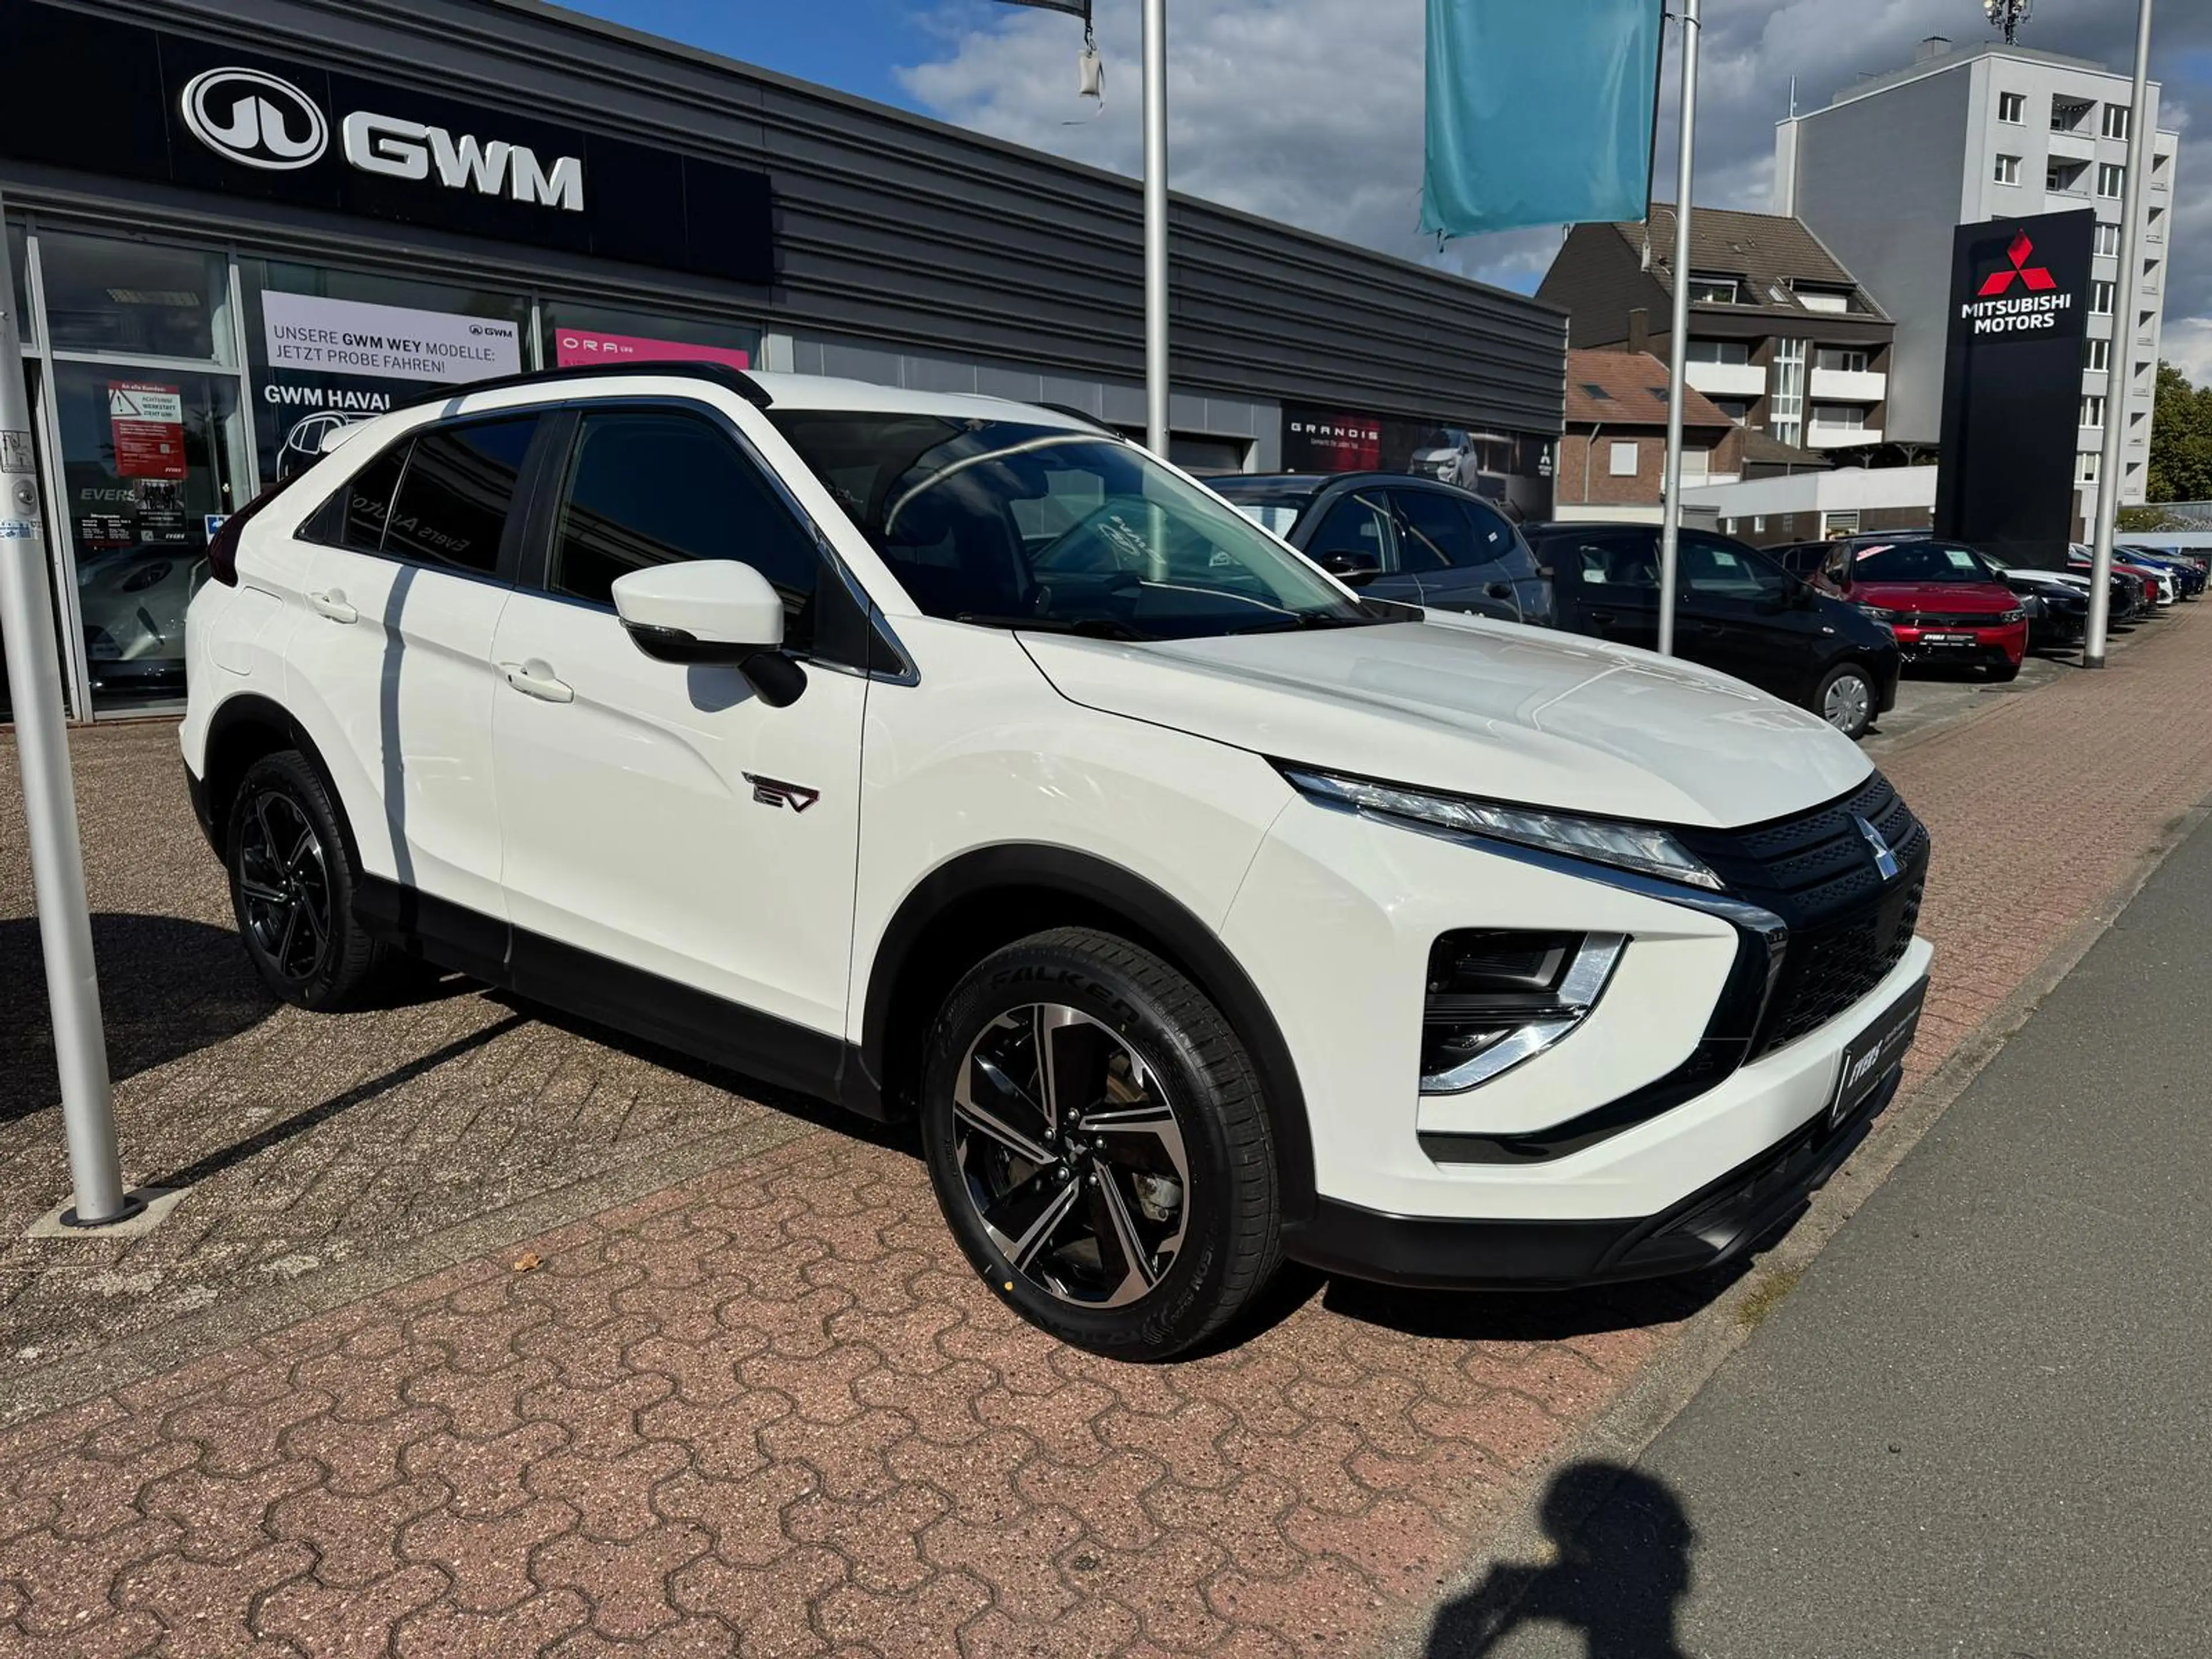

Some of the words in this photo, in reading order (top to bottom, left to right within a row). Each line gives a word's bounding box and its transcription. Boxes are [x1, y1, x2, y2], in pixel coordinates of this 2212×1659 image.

[342, 111, 584, 211] GWM
[1961, 294, 2071, 319] MITSUBISHI
[484, 328, 513, 338] GWM
[1974, 313, 2055, 334] MOTORS
[274, 325, 338, 344] UNSERE
[342, 333, 383, 349] GWM
[387, 338, 422, 353] WEY
[426, 342, 495, 362] MODELLE:
[563, 337, 618, 353] ORA
[276, 346, 323, 362] JETZT
[328, 350, 380, 368] PROBE
[384, 355, 445, 374] FAHREN!
[264, 384, 323, 407] GWM
[1291, 422, 1378, 440] GRANDIS
[80, 488, 135, 502] EVERS
[990, 967, 1141, 1024] FALKEN
